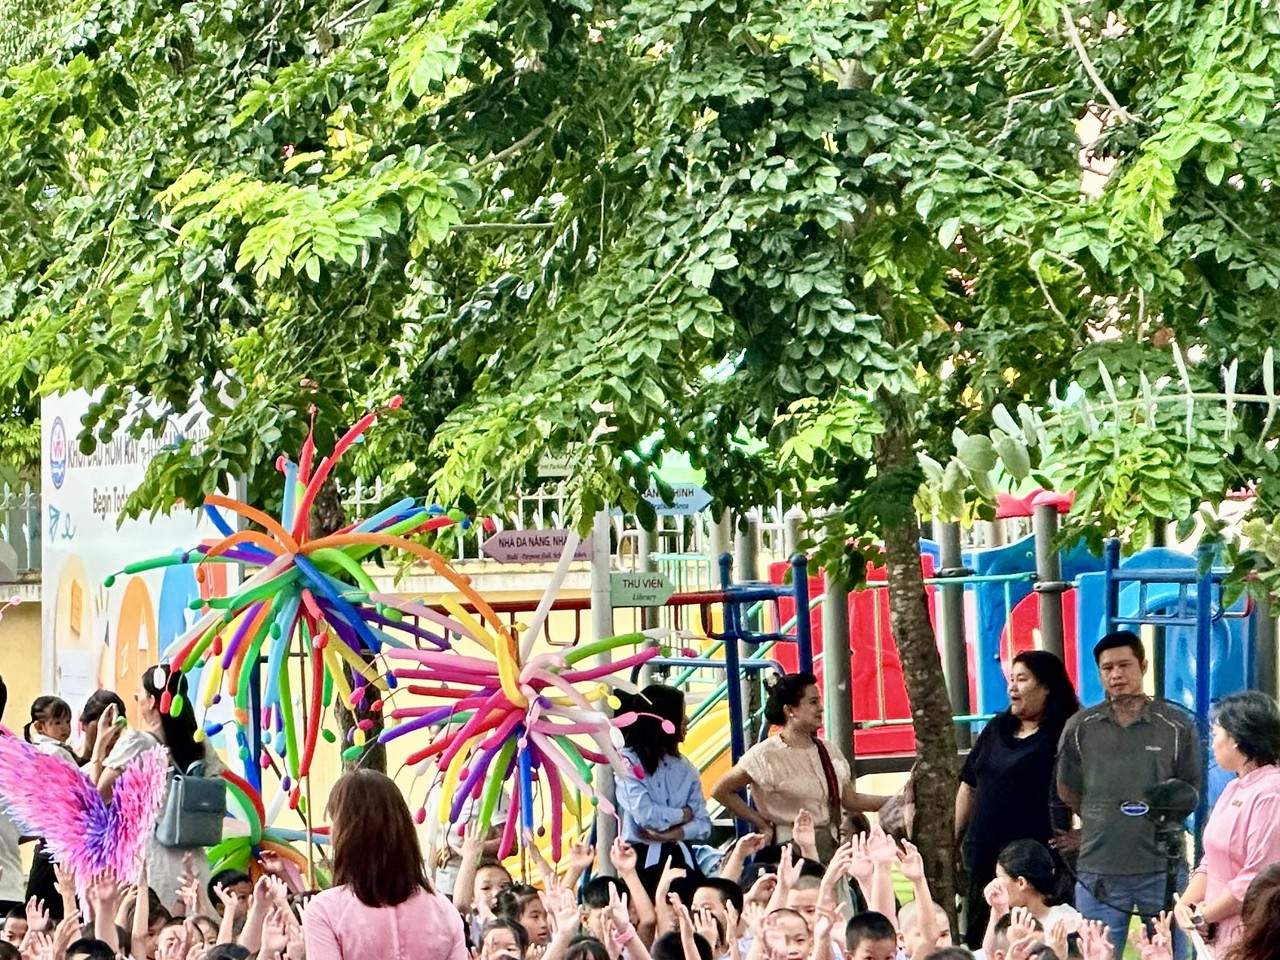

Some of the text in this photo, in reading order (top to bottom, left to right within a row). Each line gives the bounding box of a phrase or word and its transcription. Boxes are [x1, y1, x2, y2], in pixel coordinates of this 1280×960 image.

[93, 487, 111, 521] Begin
[623, 576, 664, 590] THƯ VIỆN
[632, 593, 657, 601] Library
